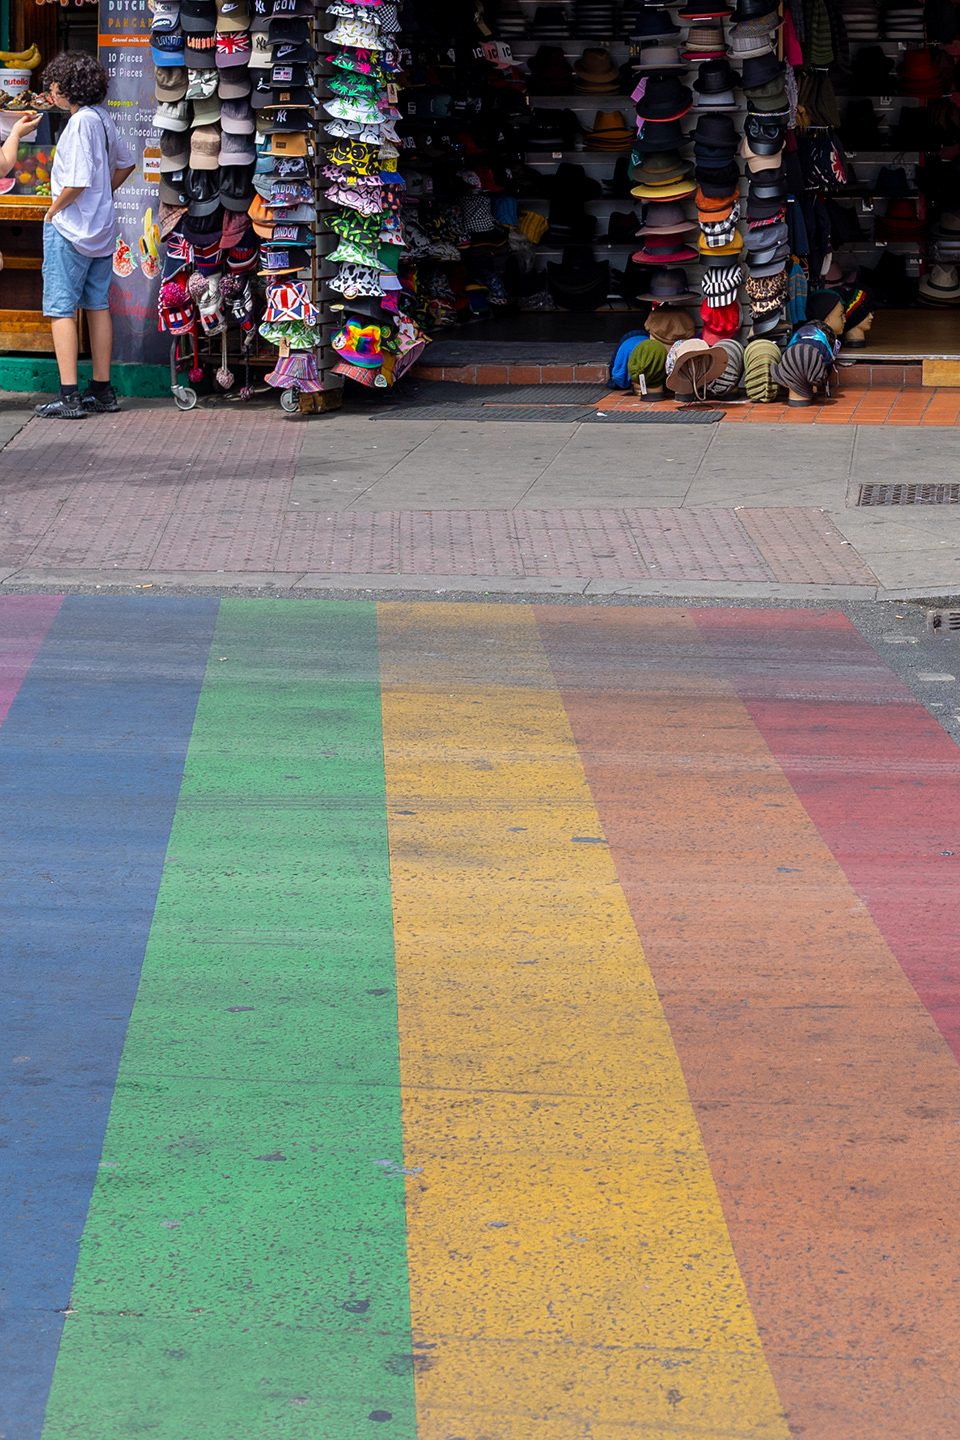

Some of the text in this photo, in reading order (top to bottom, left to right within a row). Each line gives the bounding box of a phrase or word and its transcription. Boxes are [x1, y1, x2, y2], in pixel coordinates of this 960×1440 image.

[108, 0, 145, 11] DUTCH
[273, 0, 296, 12] ICON
[108, 17, 153, 28] PANCAK
[108, 52, 143, 63] 10 Pieces
[108, 67, 143, 78] 15 Pieces
[107, 100, 134, 108] toppings
[109, 111, 132, 122] White
[115, 186, 160, 197] rawberries
[113, 202, 140, 211] ananas
[117, 215, 137, 225] rries
[273, 226, 298, 240] LONDON
[110, 284, 133, 301] Pizza
[109, 300, 158, 321] Warehou
